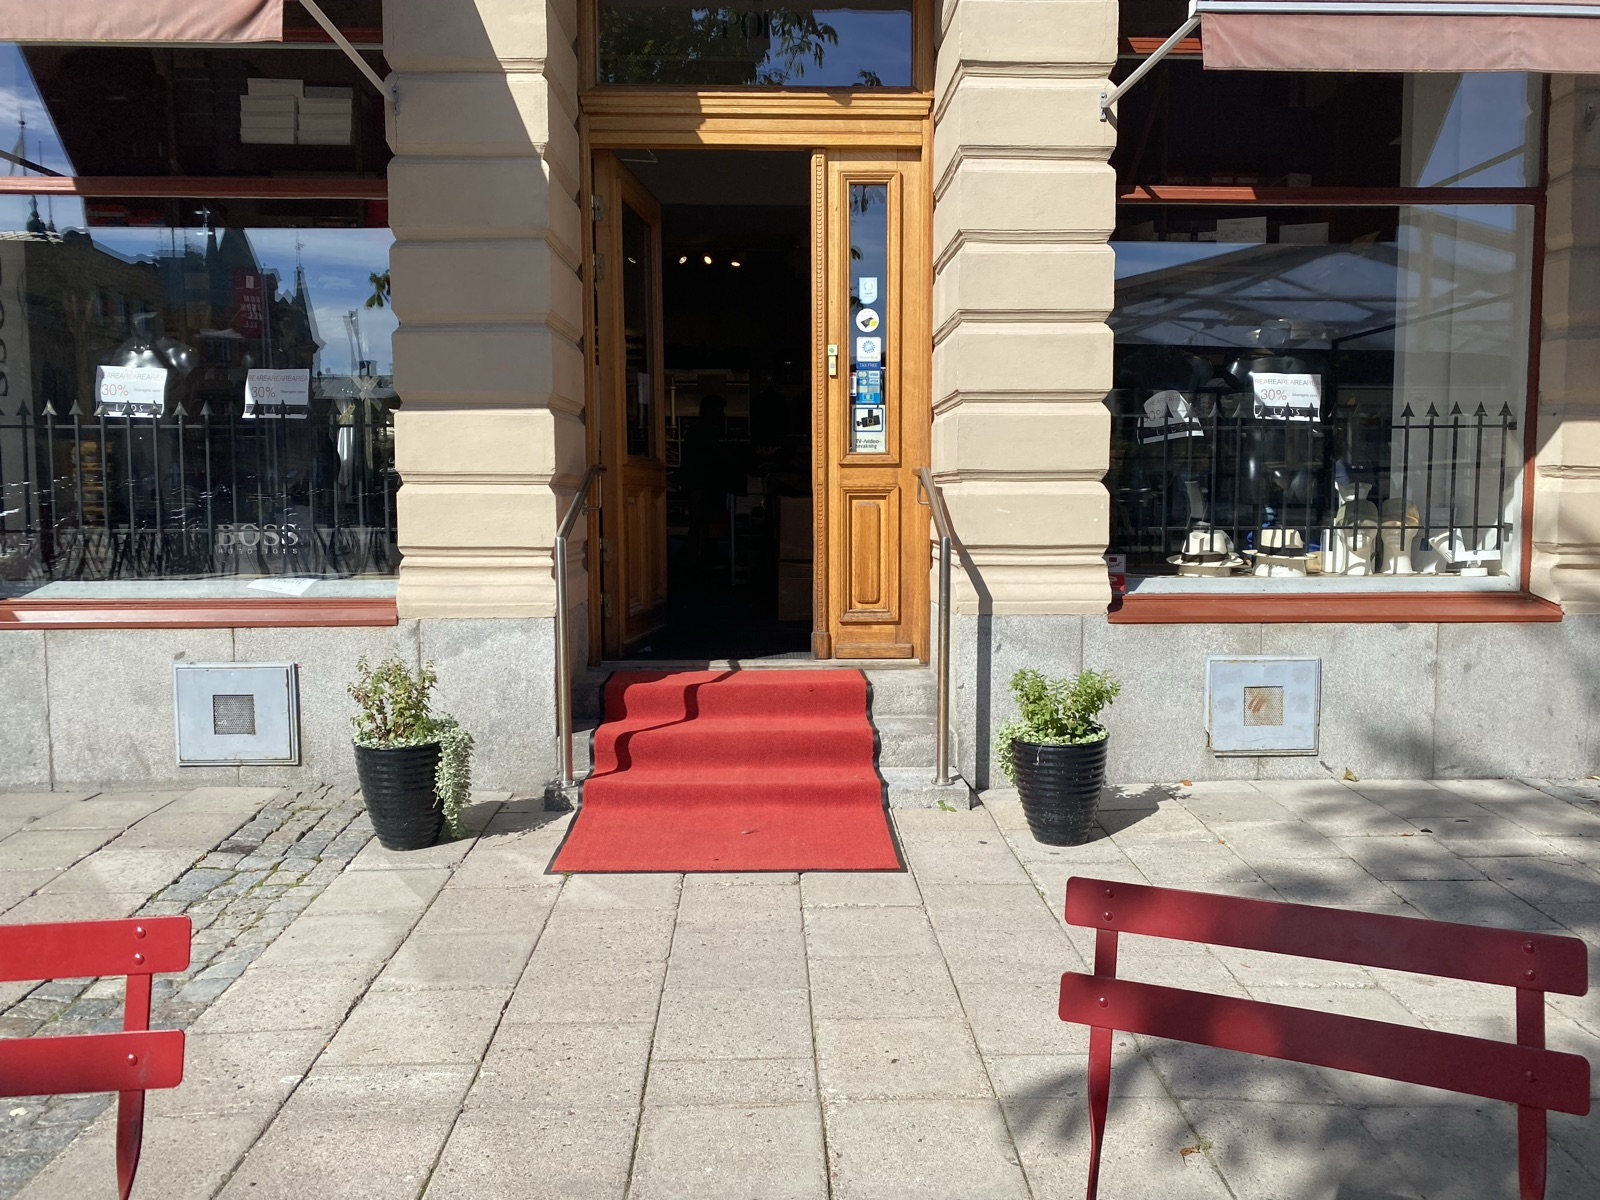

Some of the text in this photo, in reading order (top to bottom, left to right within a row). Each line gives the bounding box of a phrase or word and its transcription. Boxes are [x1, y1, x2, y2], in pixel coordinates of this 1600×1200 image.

[101, 383, 129, 396] 30%
[251, 386, 276, 398] 30%
[1260, 388, 1287, 401] 30%
[216, 523, 299, 546] BOSS
